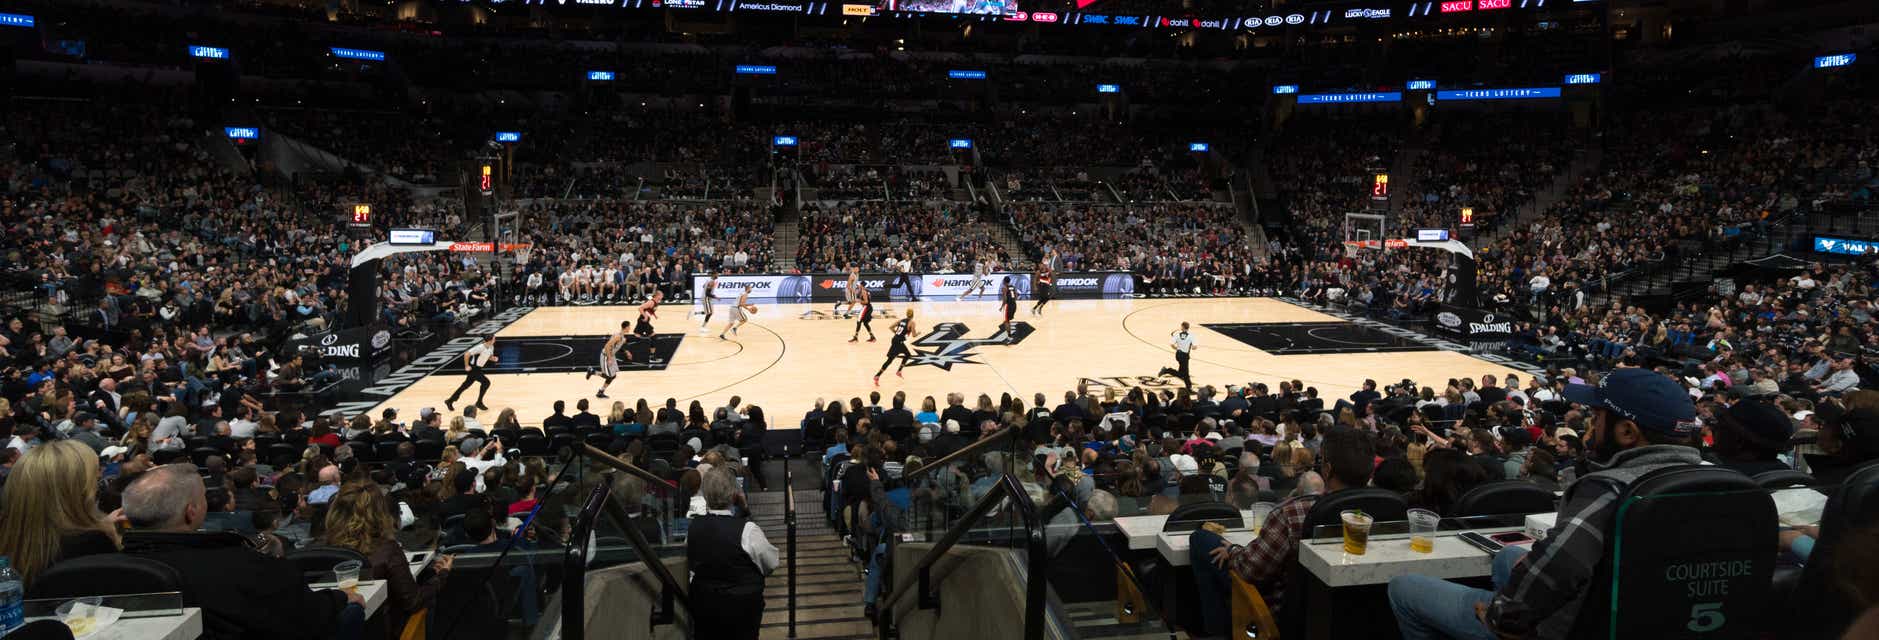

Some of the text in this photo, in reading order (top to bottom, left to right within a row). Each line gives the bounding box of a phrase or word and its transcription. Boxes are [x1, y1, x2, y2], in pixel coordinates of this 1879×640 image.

[739, 3, 802, 11] Americus Diamond
[1441, 2, 1471, 12] SACU
[1480, 0, 1510, 9] SACU
[1170, 18, 1189, 27] dahill
[1201, 19, 1220, 28] dahill
[1495, 89, 1531, 97] LOTTERY
[1375, 183, 1387, 194] 21
[355, 213, 367, 221] 21
[1469, 321, 1512, 334] SPALDING
[360, 336, 485, 396] ANTONIO
[1666, 560, 1753, 581] COURTSIDE
[1687, 579, 1729, 597] SUITE
[1687, 602, 1726, 632] 5
